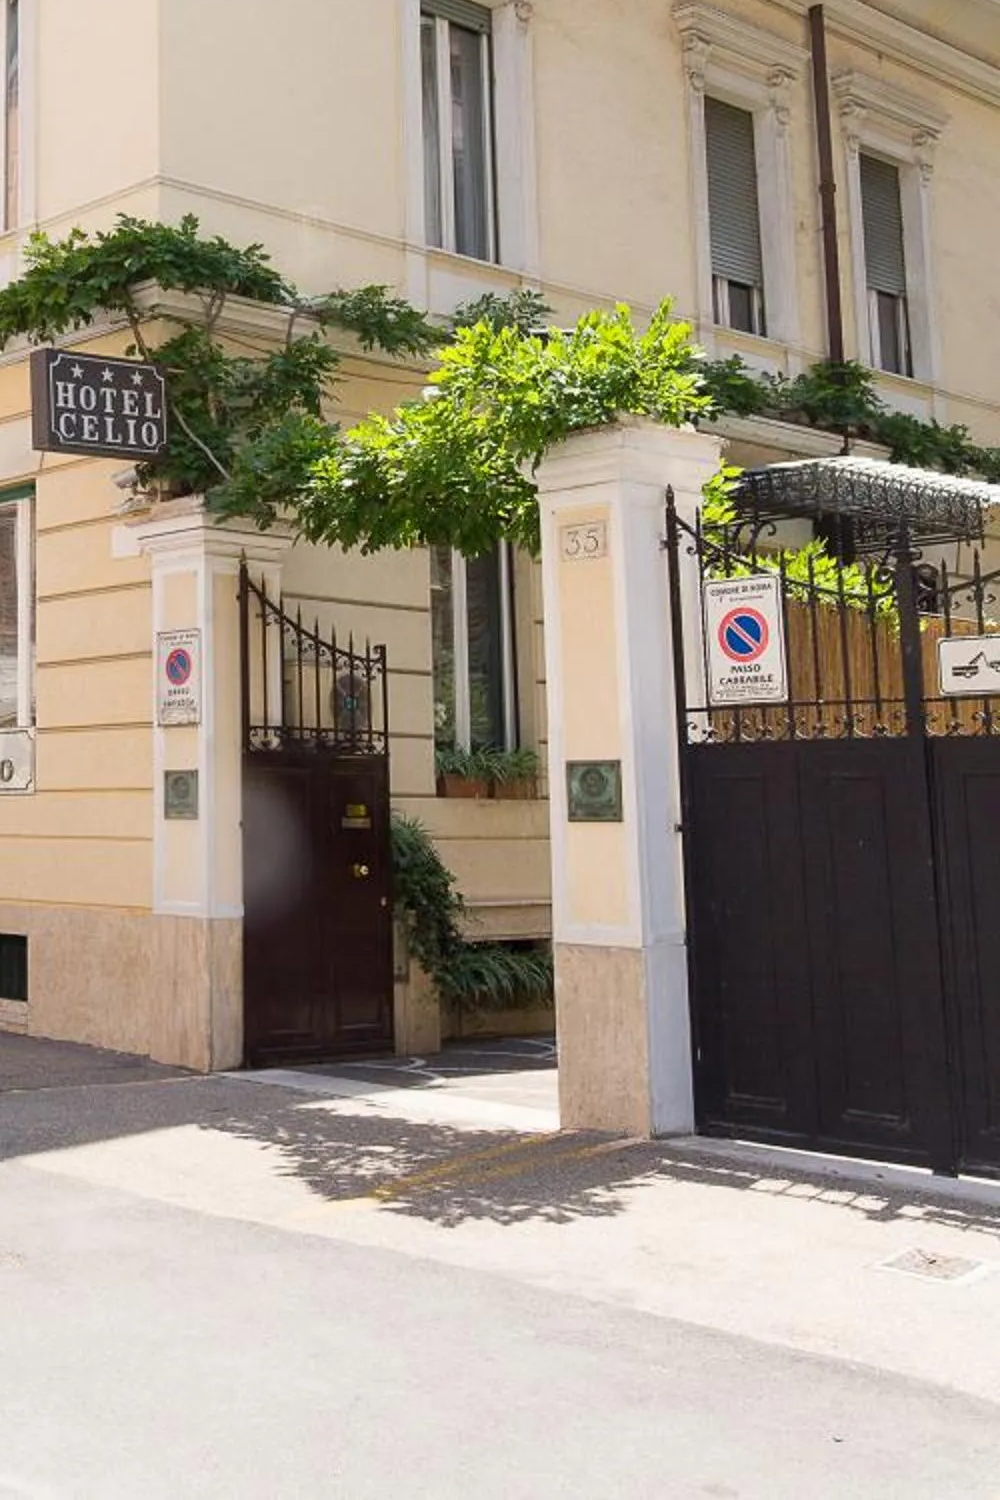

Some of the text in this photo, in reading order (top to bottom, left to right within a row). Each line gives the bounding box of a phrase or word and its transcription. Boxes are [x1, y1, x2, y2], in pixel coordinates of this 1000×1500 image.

[56, 381, 161, 419] HOTEL
[59, 413, 158, 447] CELIO
[565, 528, 599, 556] 35
